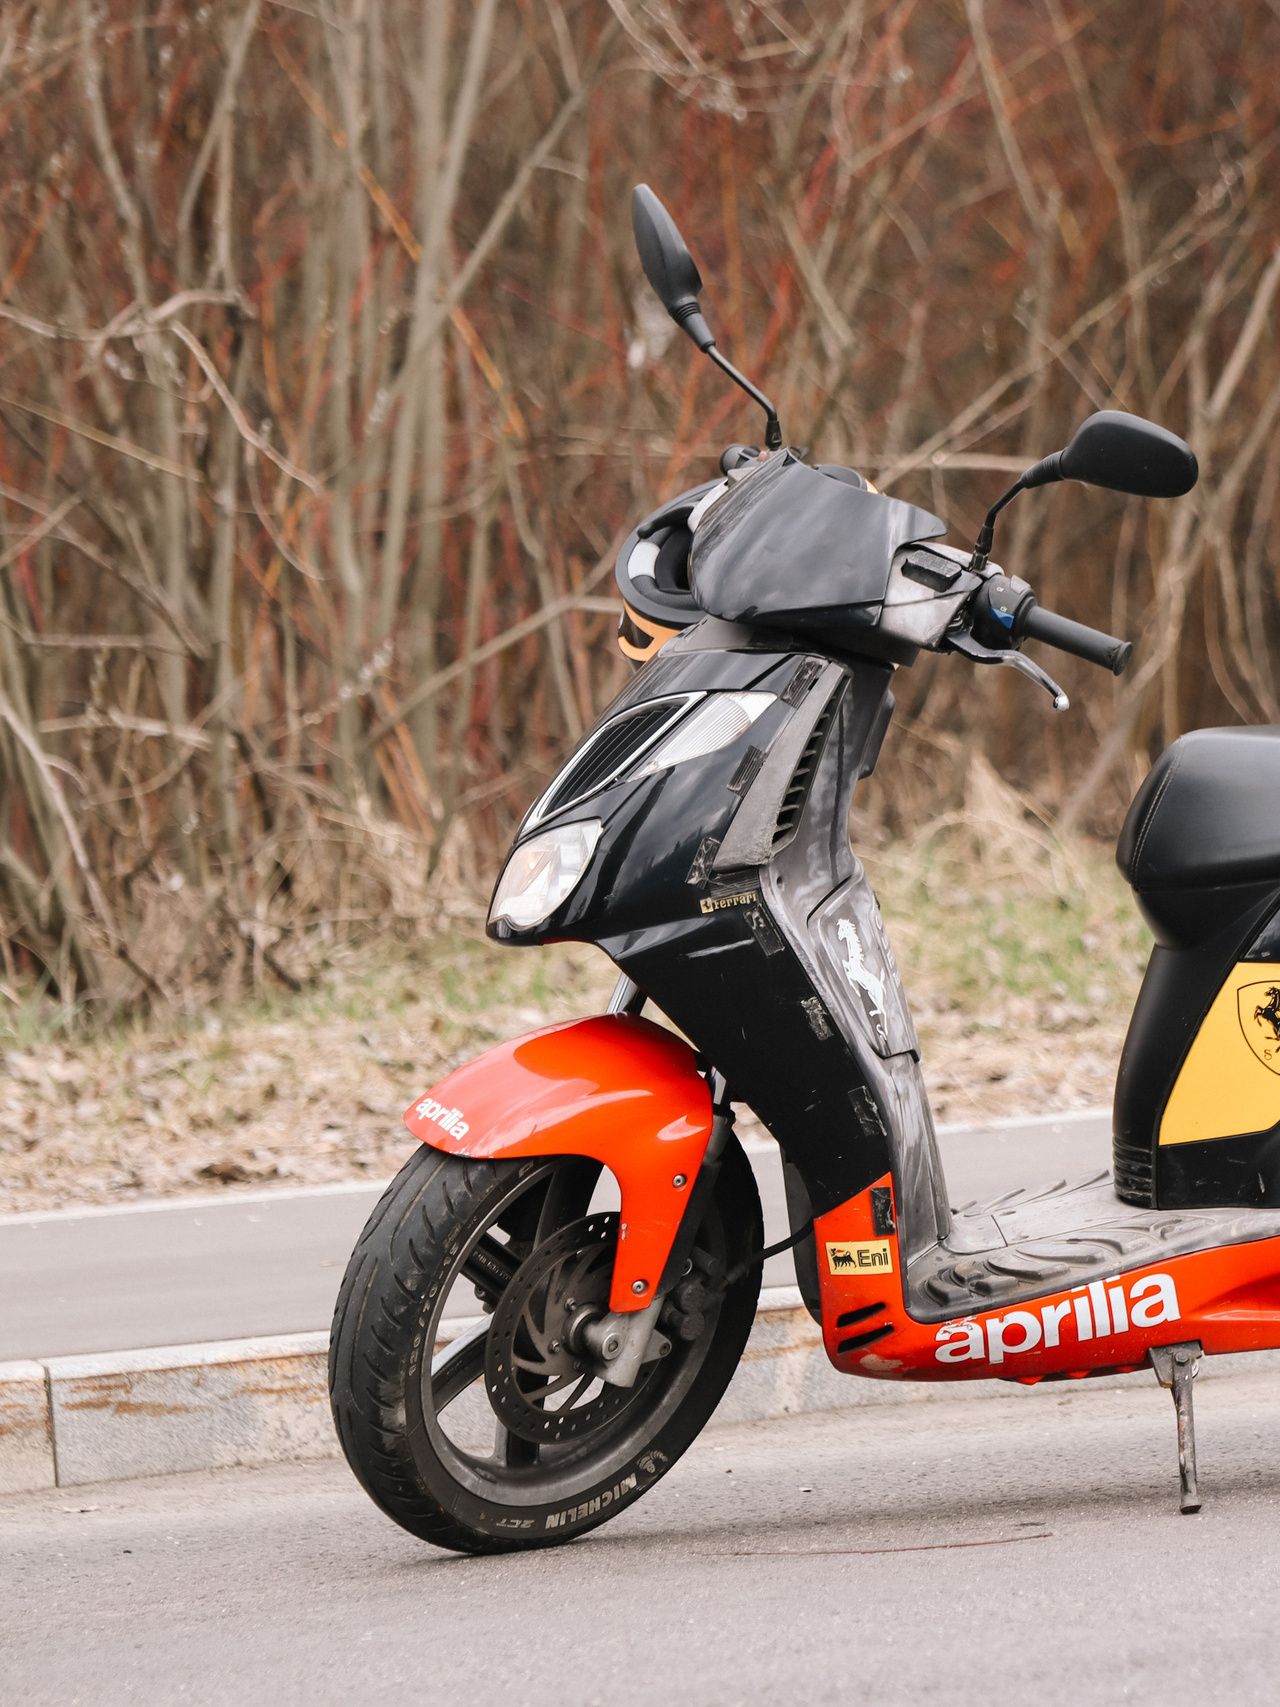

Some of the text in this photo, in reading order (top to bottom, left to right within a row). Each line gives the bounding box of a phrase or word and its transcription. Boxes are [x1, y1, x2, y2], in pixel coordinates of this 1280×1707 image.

[713, 893, 757, 910] Ferrari
[1263, 1049, 1273, 1060] S
[415, 1097, 470, 1141] aprilia
[857, 1248, 889, 1267] Eni
[934, 1273, 1182, 1365] aprilia
[545, 1473, 638, 1529] MICHELIN
